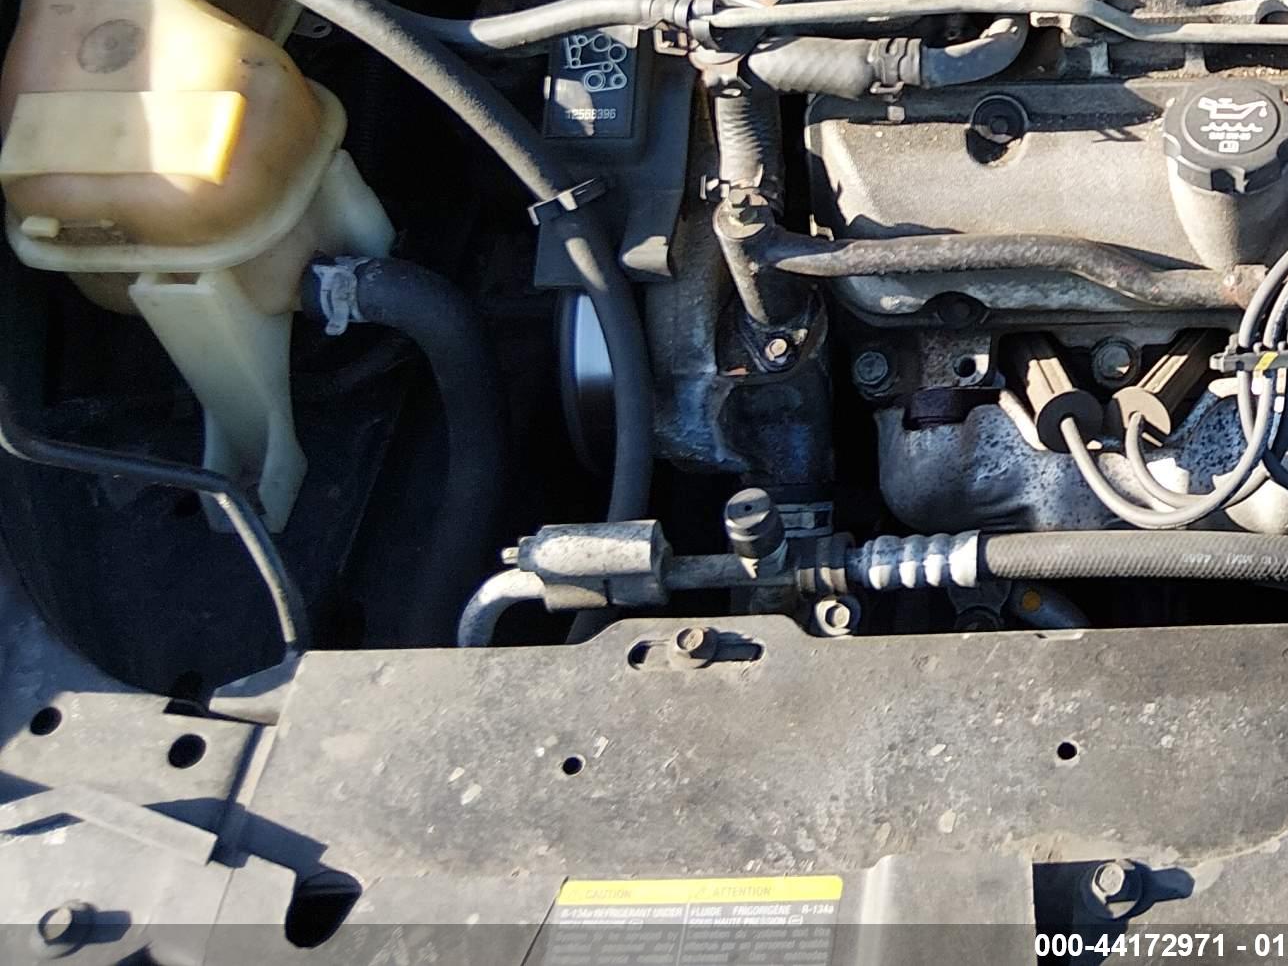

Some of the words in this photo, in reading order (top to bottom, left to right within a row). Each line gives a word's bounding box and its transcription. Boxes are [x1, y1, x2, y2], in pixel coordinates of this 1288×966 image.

[586, 889, 633, 900] CAUTION
[711, 886, 772, 898] ATTENTION
[690, 906, 723, 917] FLUIDE
